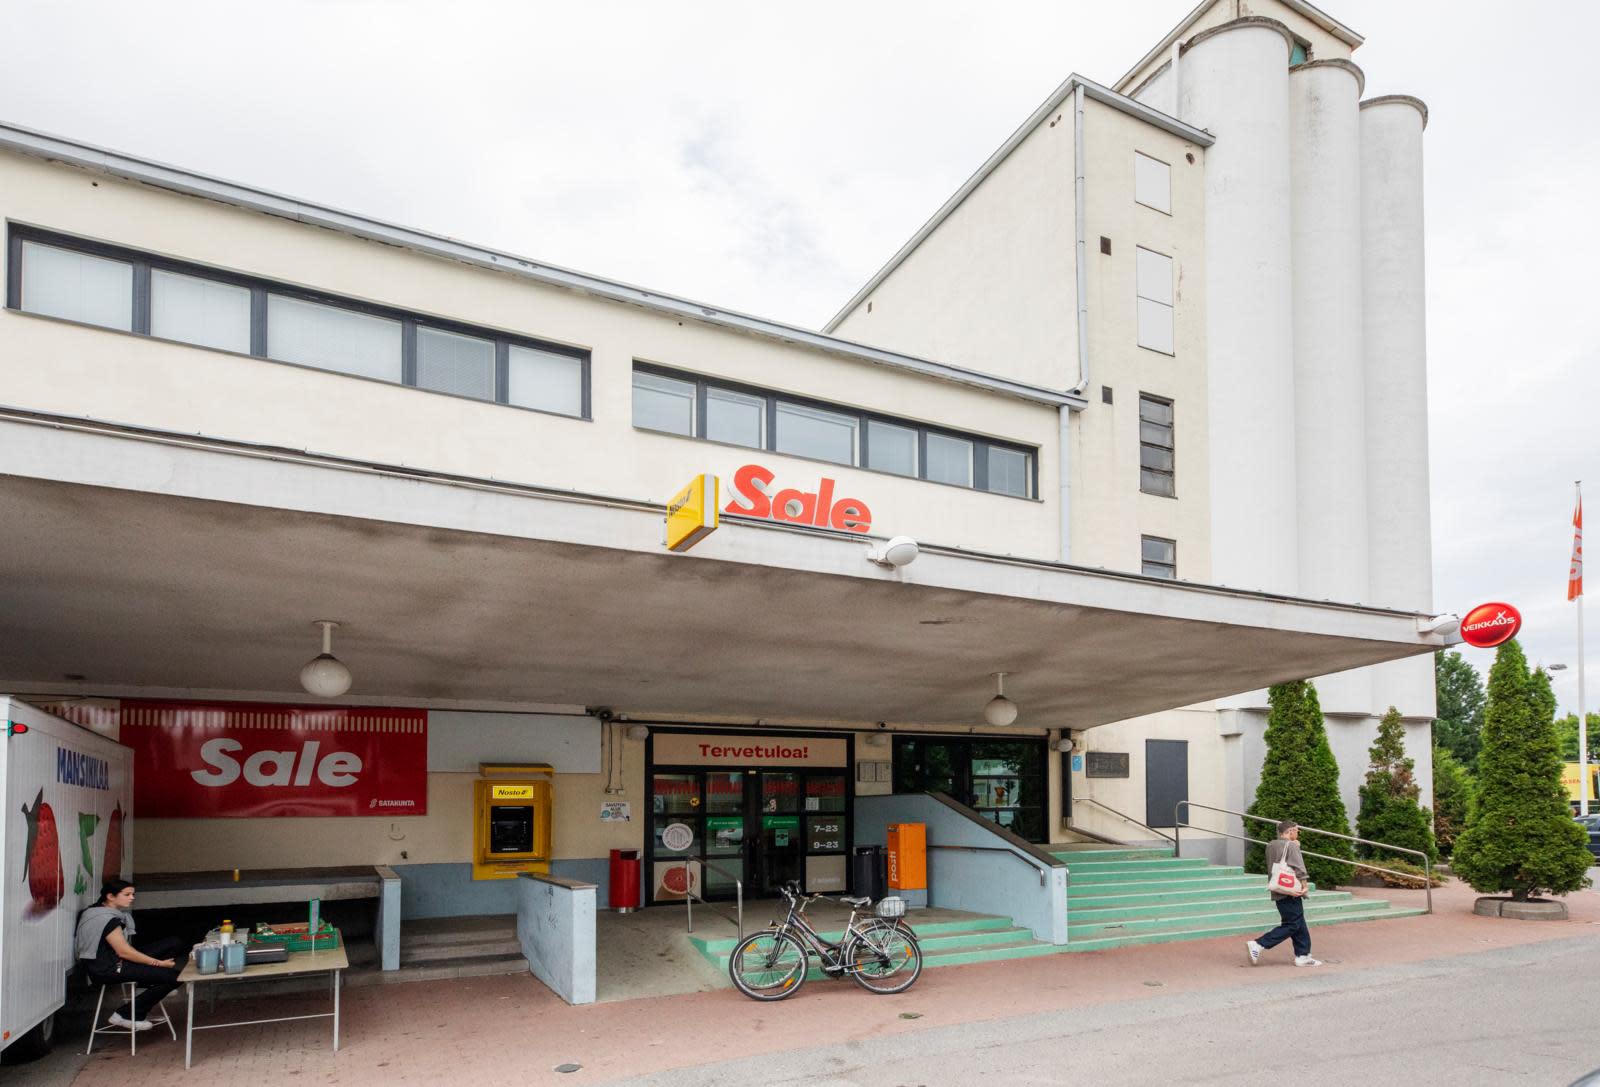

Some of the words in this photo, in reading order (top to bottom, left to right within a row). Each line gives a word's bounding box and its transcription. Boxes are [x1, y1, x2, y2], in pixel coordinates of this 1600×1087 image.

[725, 464, 872, 532] Sale
[1463, 615, 1516, 632] VEIKKAUS
[190, 737, 363, 787] Sale
[698, 744, 809, 759] Tervetuloa!
[890, 851, 899, 882] posti
